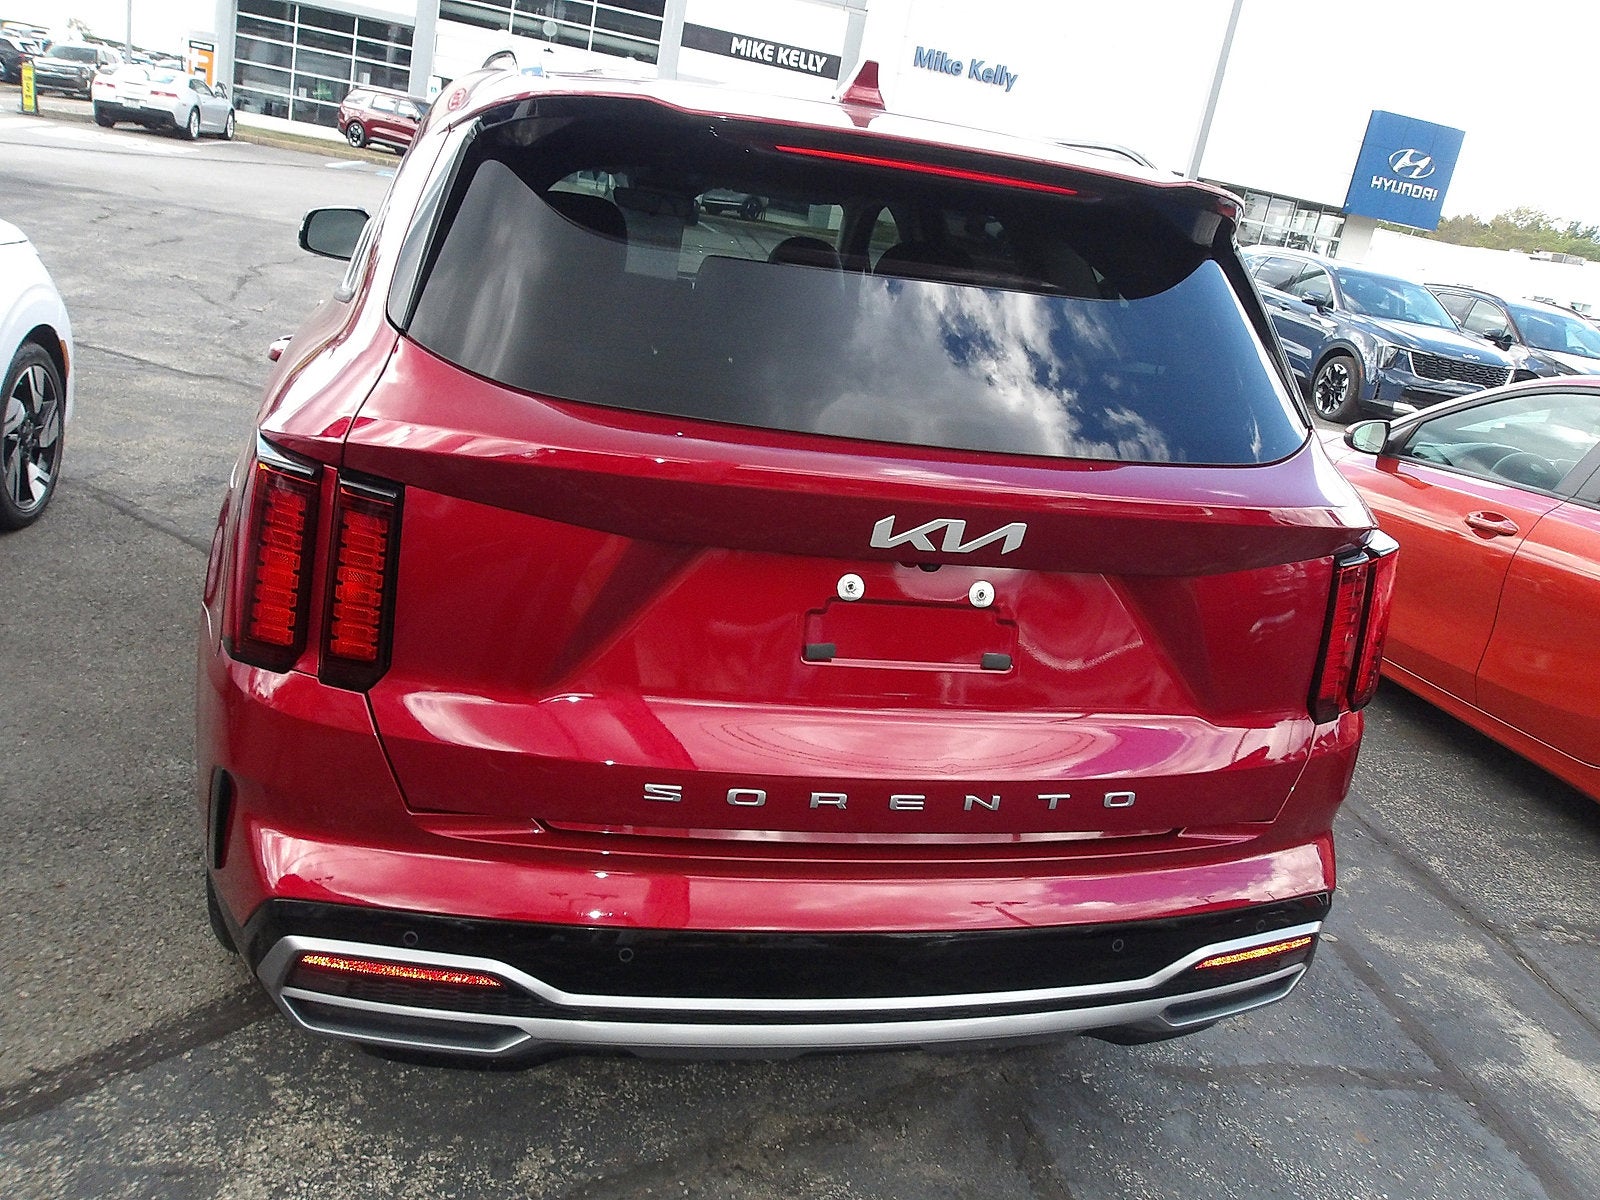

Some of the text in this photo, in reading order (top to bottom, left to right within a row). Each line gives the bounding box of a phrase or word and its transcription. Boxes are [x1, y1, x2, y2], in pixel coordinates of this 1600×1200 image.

[730, 36, 827, 73] MIKE KELLY
[914, 46, 1018, 92] Mike Kelly
[1371, 177, 1438, 201] HYUNDAI
[870, 514, 1027, 555] KIA
[643, 782, 1137, 811] SORENTO
